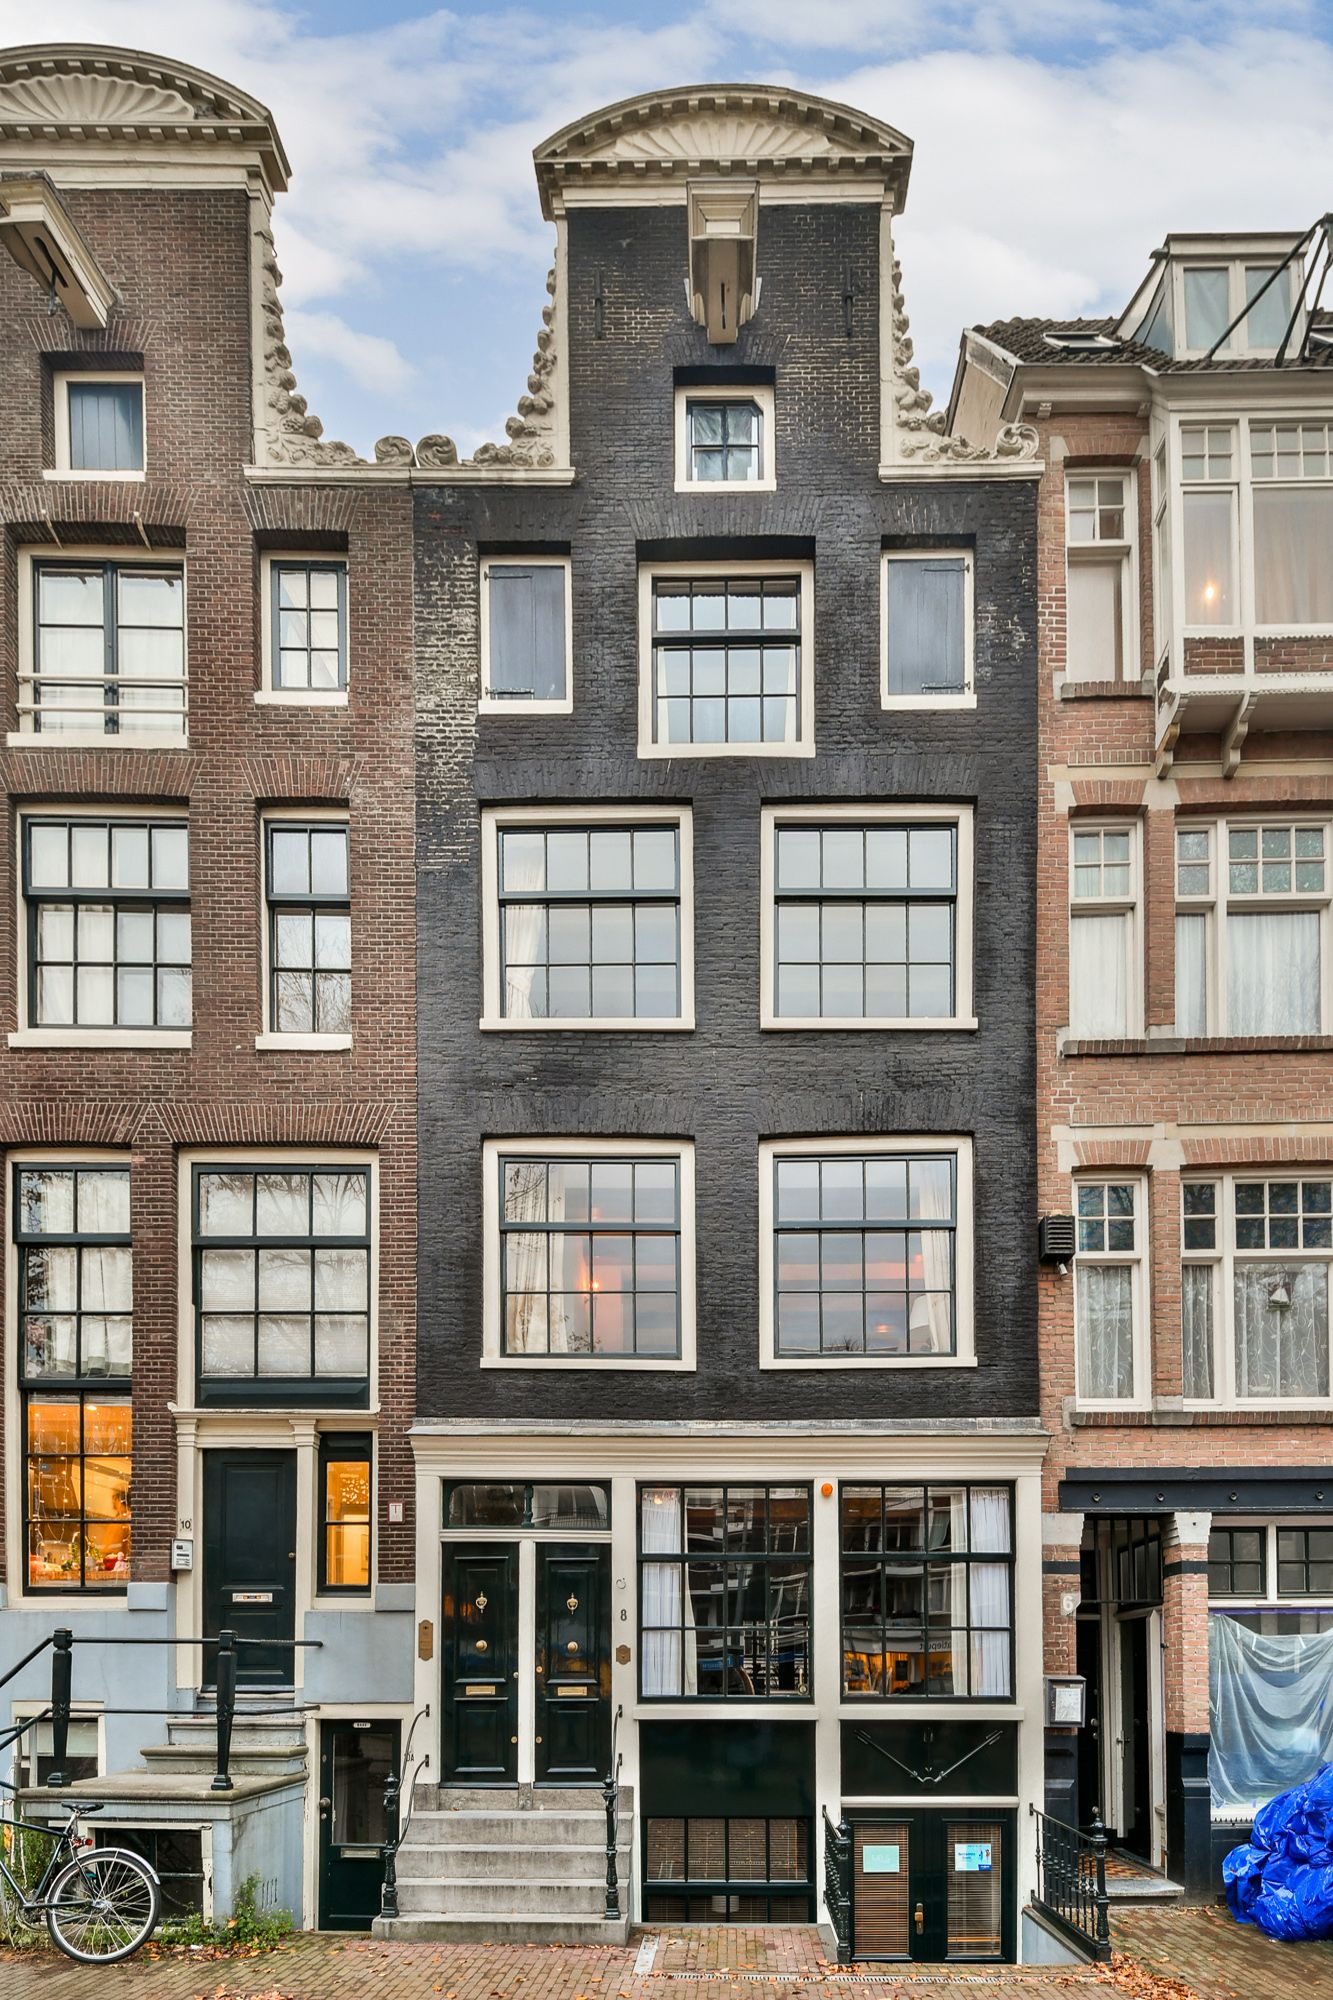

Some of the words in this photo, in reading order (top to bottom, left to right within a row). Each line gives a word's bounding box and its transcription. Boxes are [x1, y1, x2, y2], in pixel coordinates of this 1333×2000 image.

[181, 1520, 191, 1529] 10
[1063, 1595, 1074, 1611] 6
[620, 1608, 627, 1622] 8
